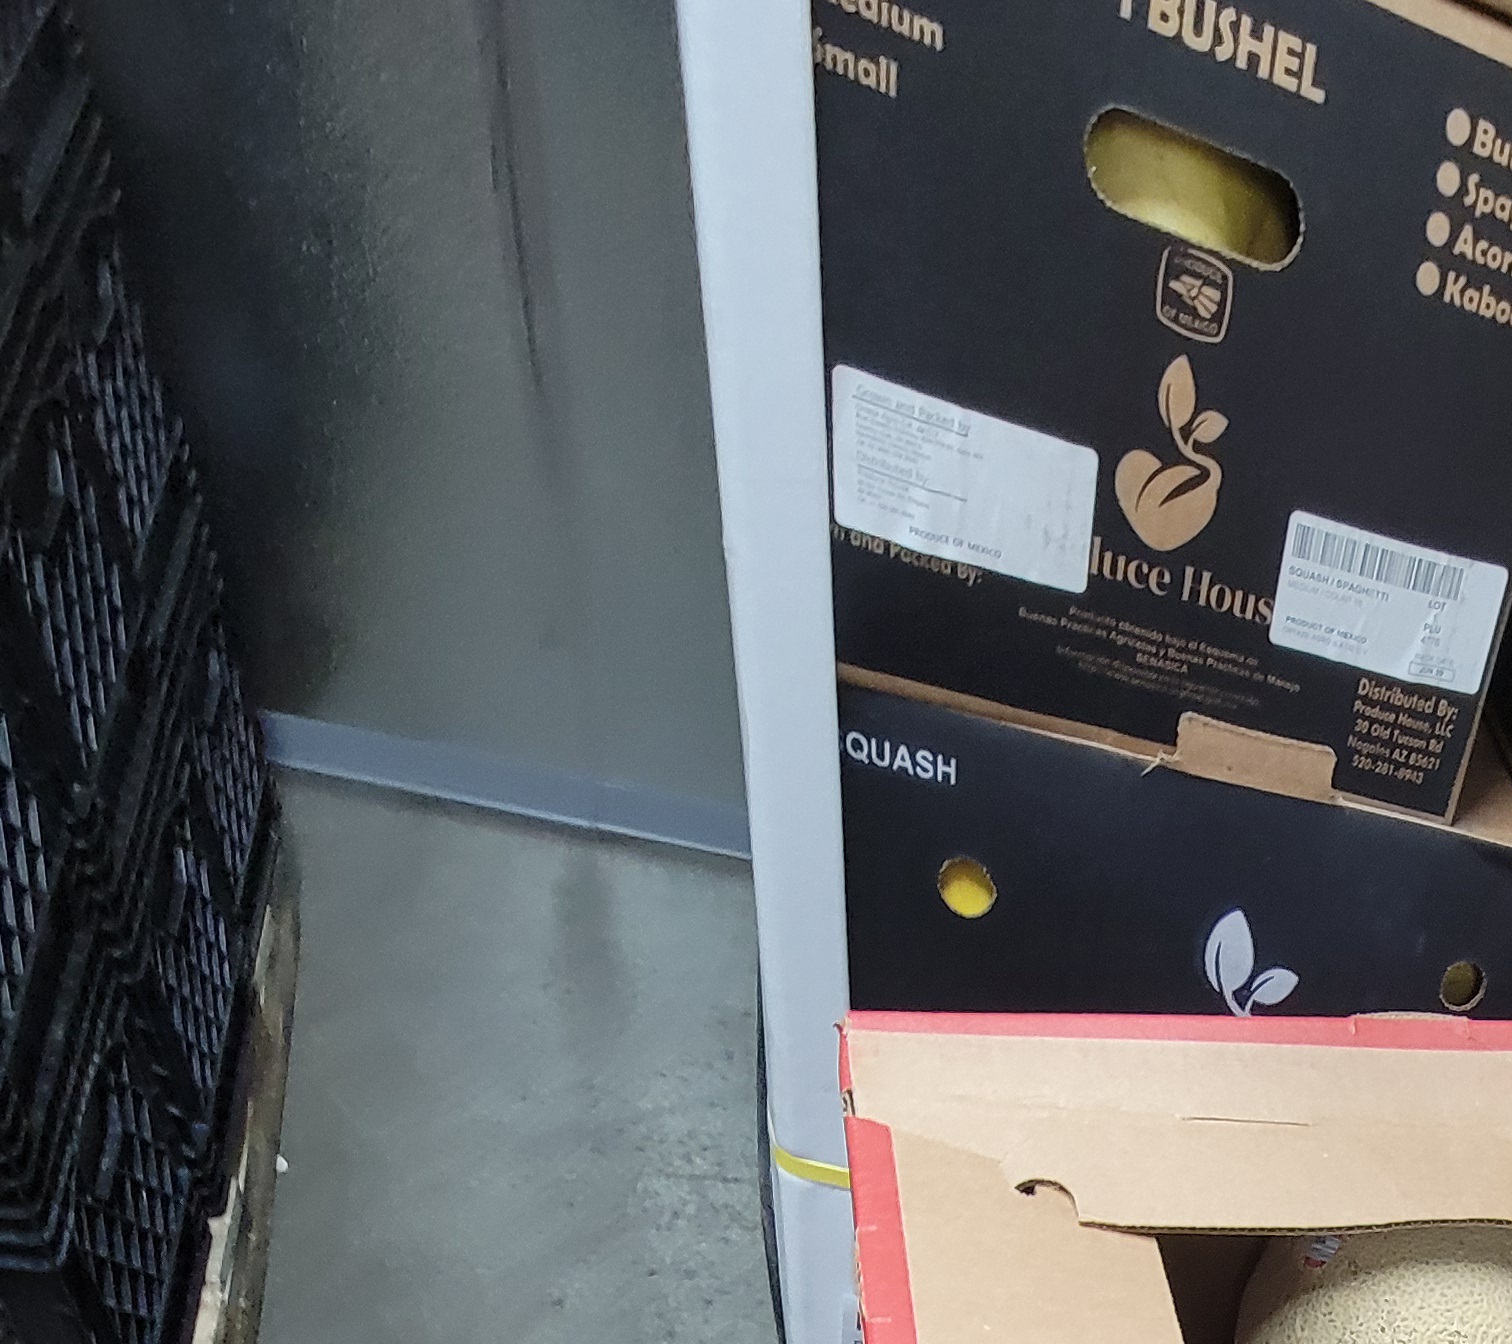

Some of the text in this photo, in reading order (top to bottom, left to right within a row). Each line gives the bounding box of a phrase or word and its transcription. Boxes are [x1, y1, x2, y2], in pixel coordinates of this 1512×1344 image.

[825, 0, 944, 51] edium
[1147, 0, 1326, 104] BUSHEL
[1357, 677, 1459, 722] Distributed By:
[841, 730, 957, 786] QUASH
